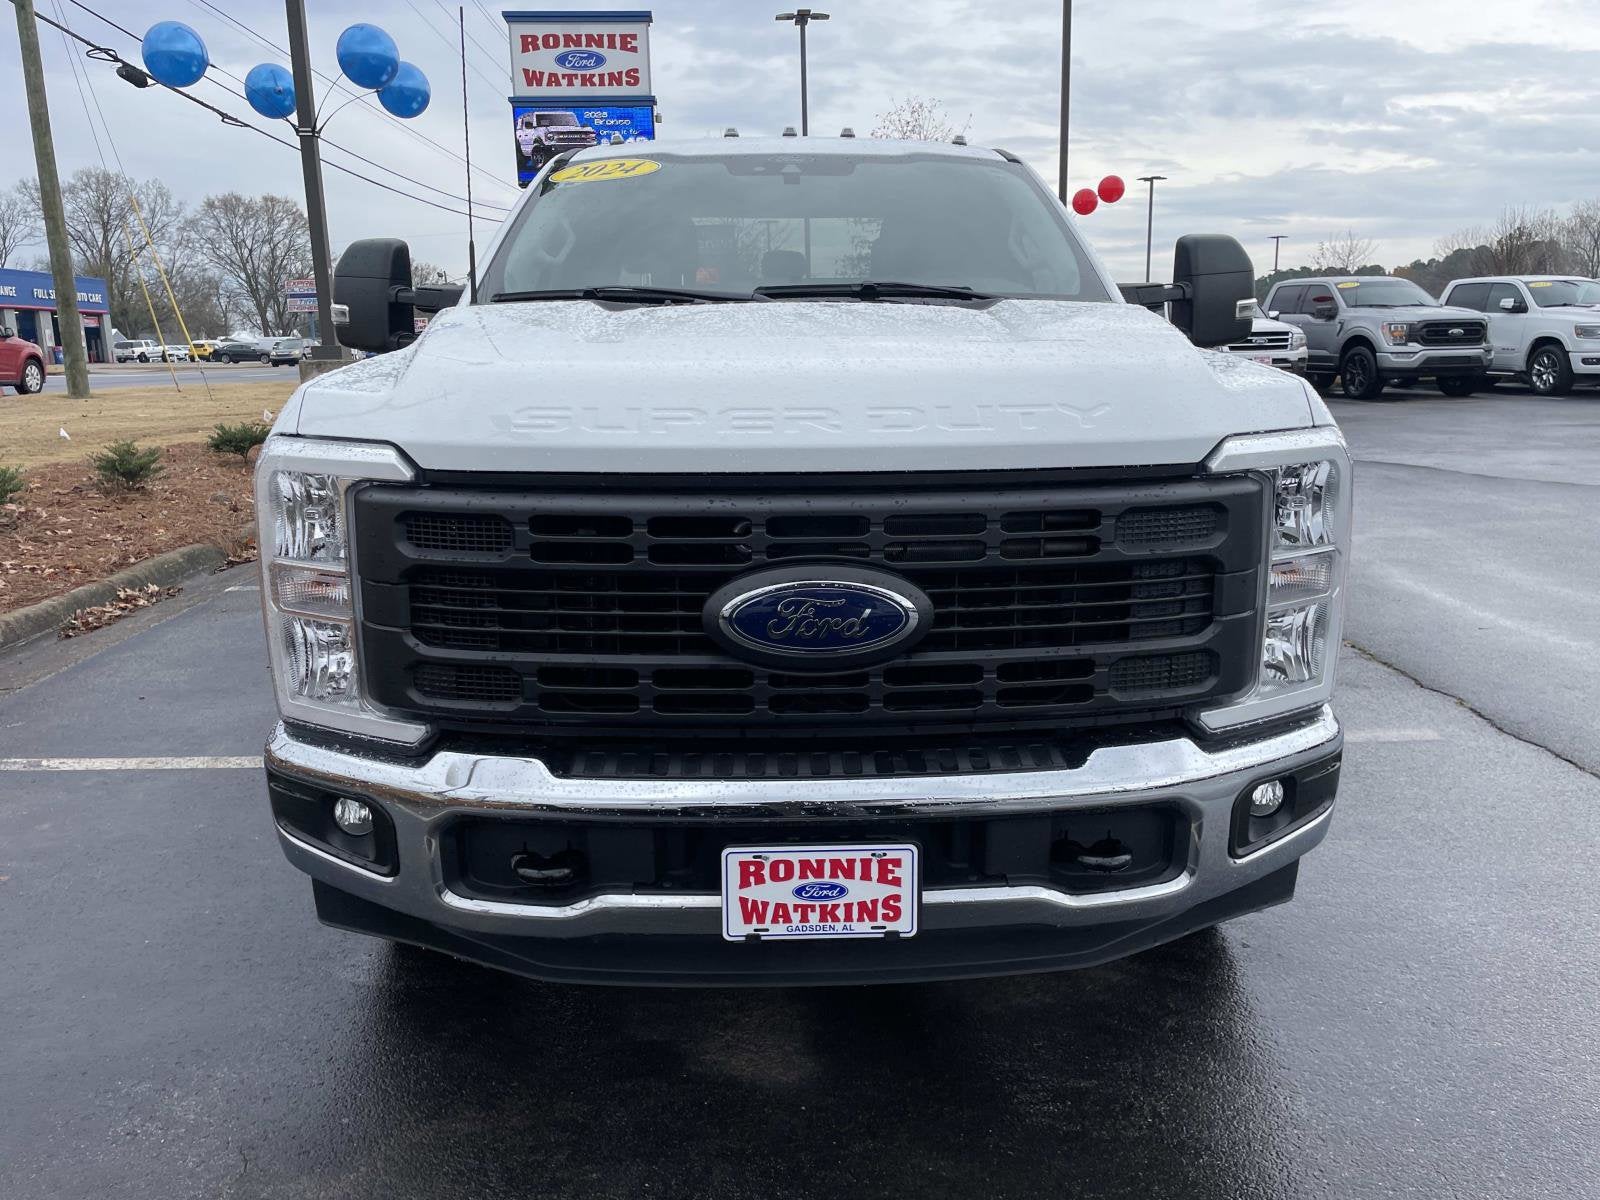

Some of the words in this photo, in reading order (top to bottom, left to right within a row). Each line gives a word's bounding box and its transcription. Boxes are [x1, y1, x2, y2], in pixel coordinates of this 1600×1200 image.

[520, 33, 638, 53] RONNIE
[565, 53, 597, 67] Ford
[522, 67, 640, 87] WATKINS
[563, 161, 646, 179] 2024
[33, 288, 49, 299] FULL
[88, 292, 103, 303] CARE
[511, 405, 842, 434] SUPER
[866, 402, 1112, 433] DUTY
[767, 597, 872, 639] Ford
[738, 857, 903, 890] RONNIE
[801, 884, 842, 898] Ford
[738, 893, 903, 925] WATKINS
[786, 923, 839, 933] GADSDEN,
[842, 923, 855, 932] AL
